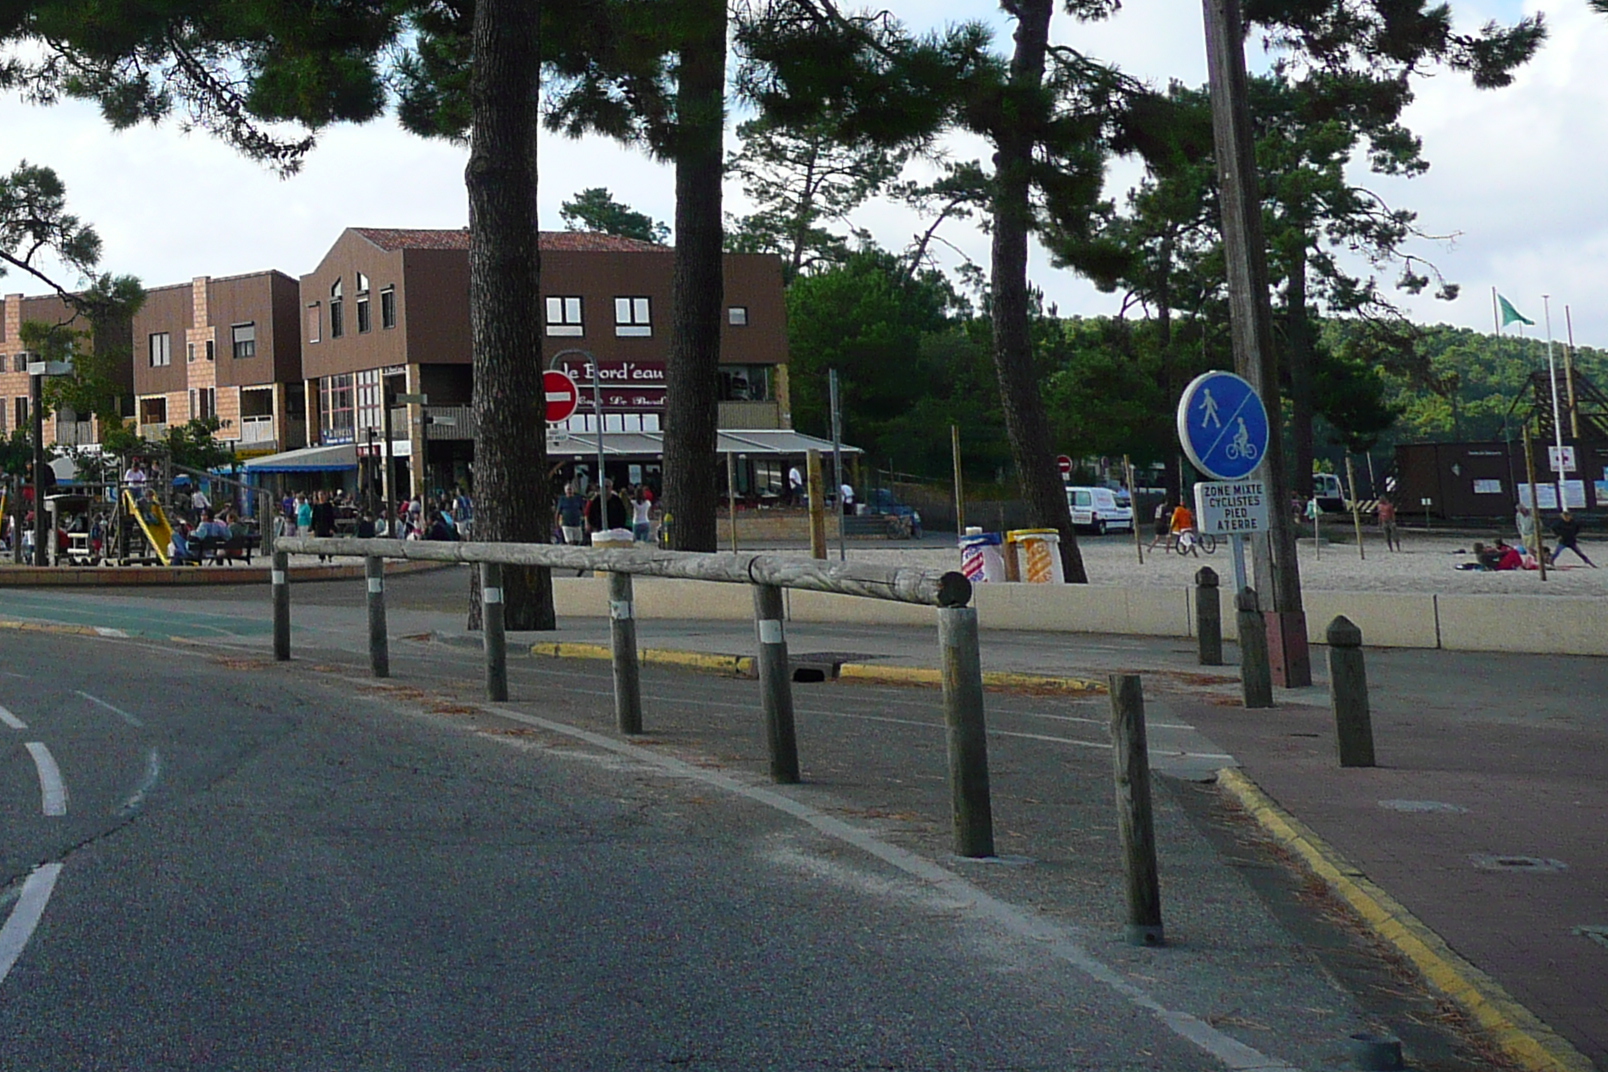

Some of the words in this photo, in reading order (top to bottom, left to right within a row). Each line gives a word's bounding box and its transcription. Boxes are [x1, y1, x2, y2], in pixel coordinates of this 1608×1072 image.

[1204, 485, 1230, 497] ZONE
[1233, 484, 1263, 495] MIXTE
[1209, 496, 1261, 508] CYCLISTES
[1225, 508, 1248, 518] PIED
